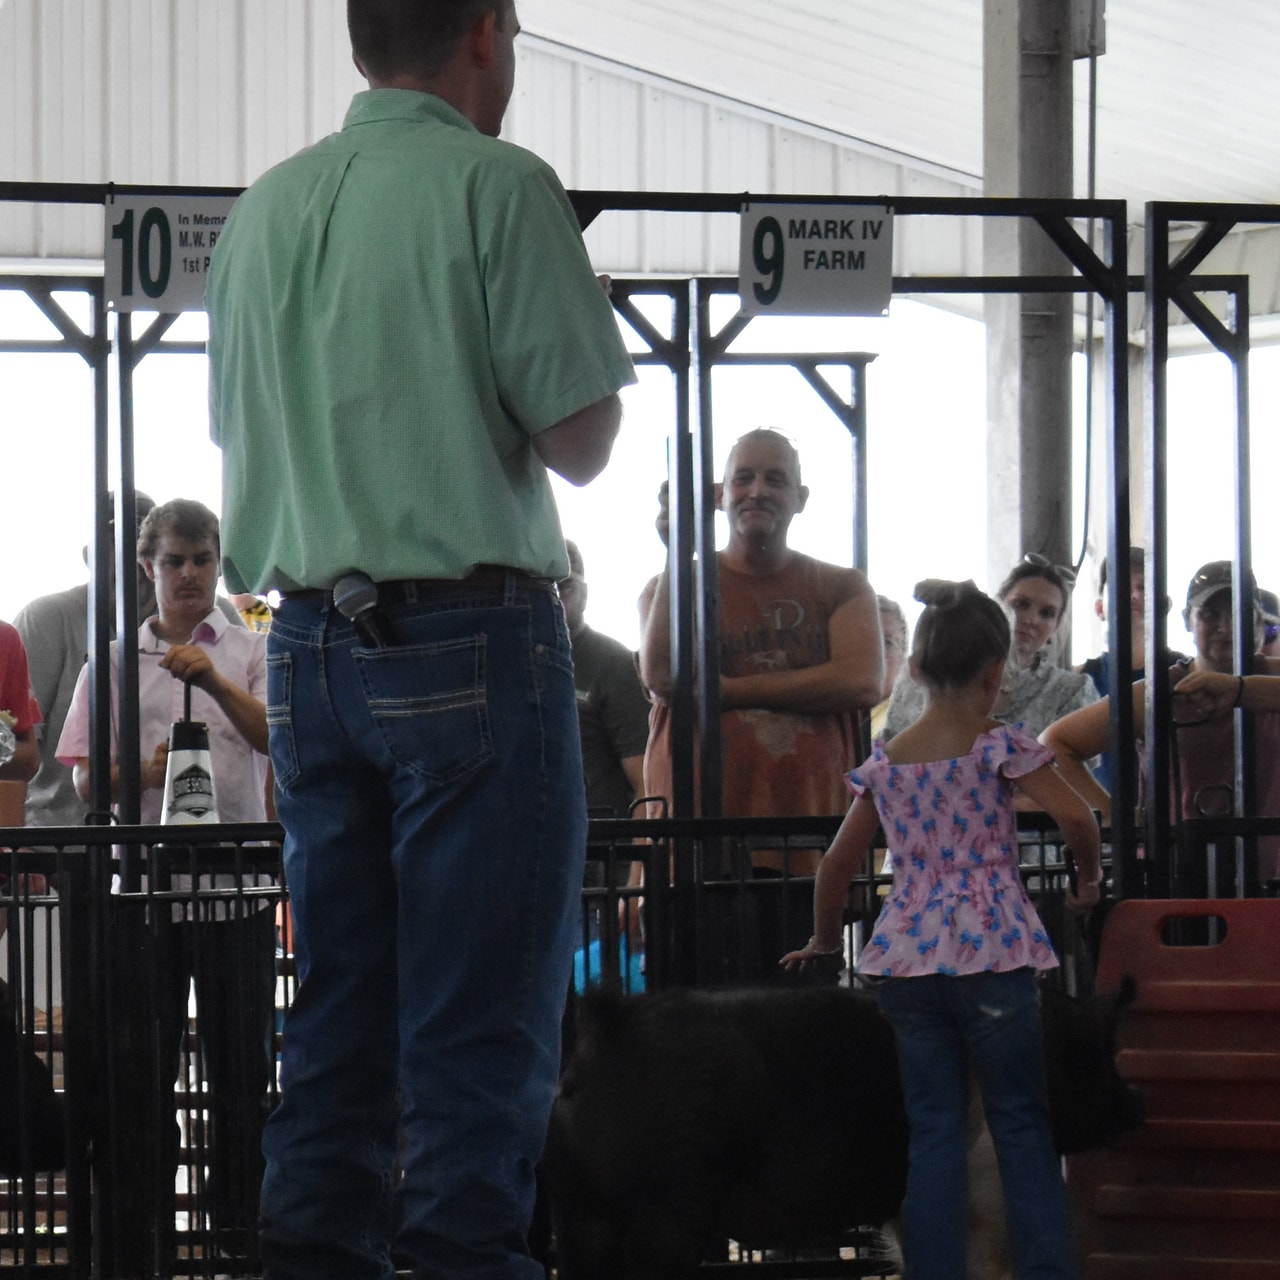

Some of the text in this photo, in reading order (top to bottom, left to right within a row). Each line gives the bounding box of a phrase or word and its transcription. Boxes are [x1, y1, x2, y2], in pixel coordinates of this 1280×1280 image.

[178, 214, 189, 225] In
[788, 219, 883, 240] MARK IV
[179, 231, 205, 248] M.W.
[112, 206, 172, 298] 10
[752, 215, 784, 306] 9
[803, 250, 866, 271] FARM
[183, 257, 200, 273] 1st
